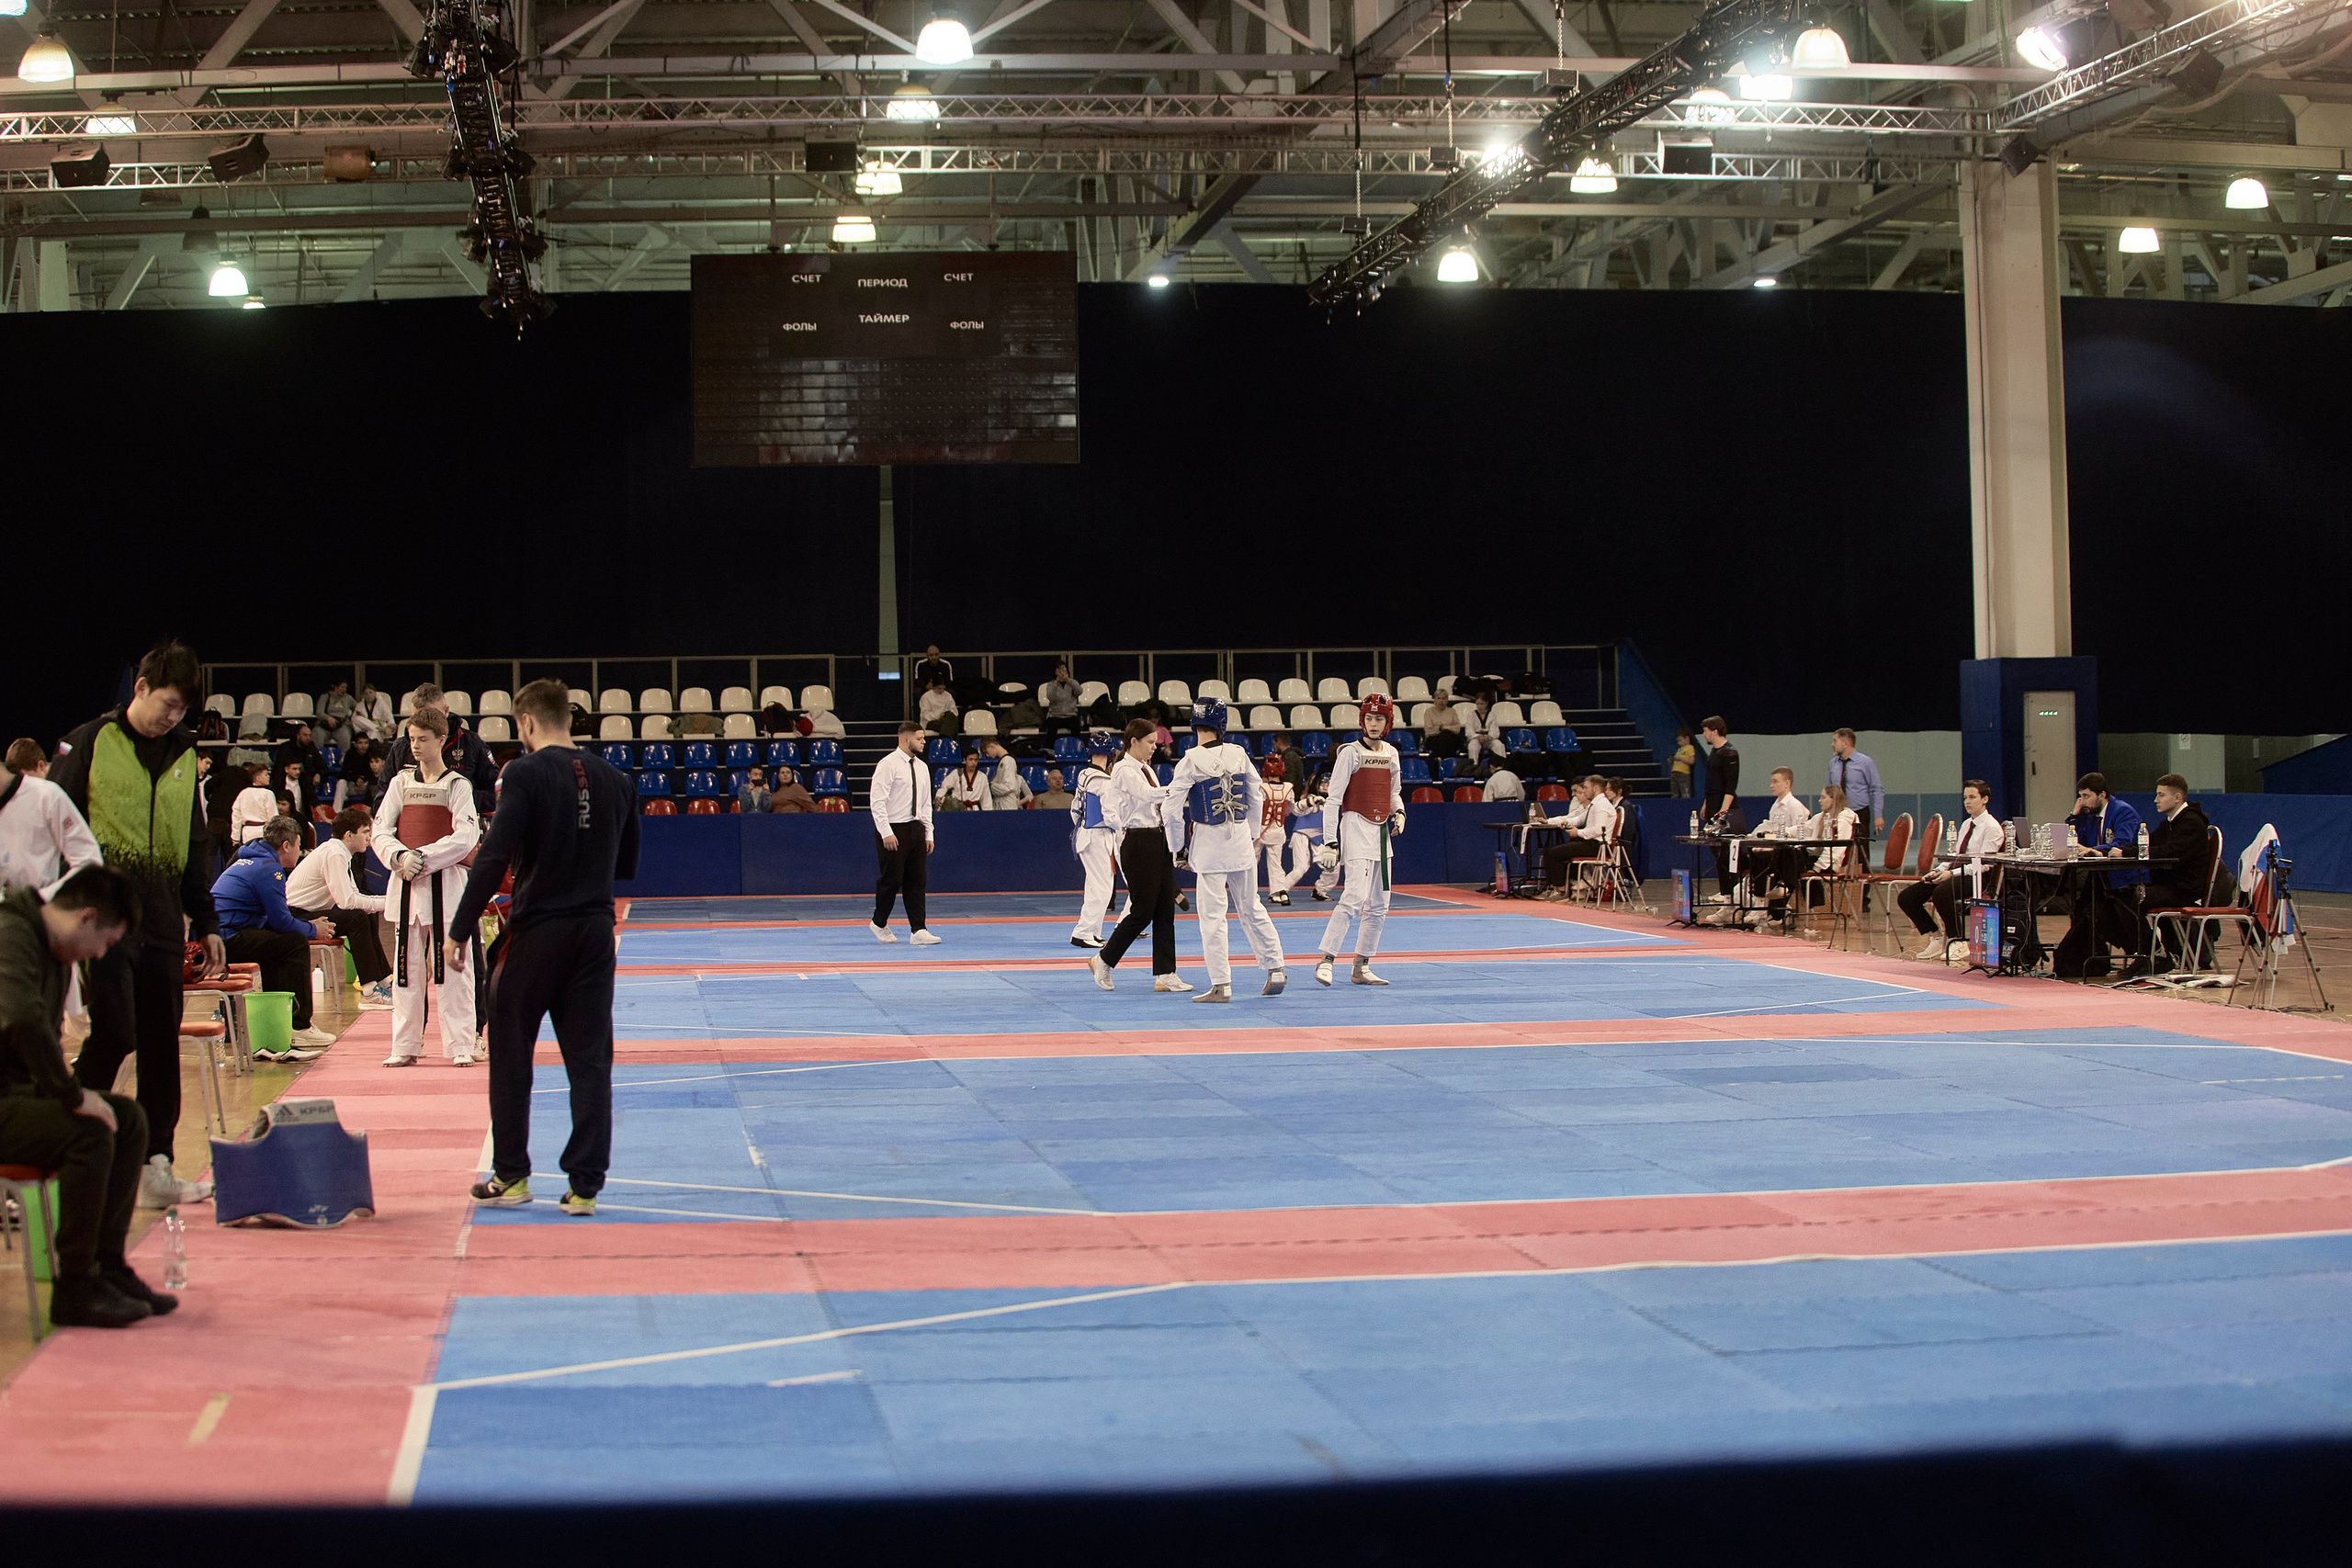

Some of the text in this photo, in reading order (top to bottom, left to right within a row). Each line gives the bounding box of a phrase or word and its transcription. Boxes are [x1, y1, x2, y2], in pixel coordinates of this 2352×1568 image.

[791, 274, 821, 283] СЧЕТ
[944, 273, 974, 282] СЧЕТ
[857, 278, 908, 288] ПЕРИОД
[858, 312, 910, 323] ТАЙМЕР
[783, 321, 818, 332] ФОЛЫ
[949, 321, 985, 330] ФОЛЫ
[1732, 845, 1737, 861] 2
